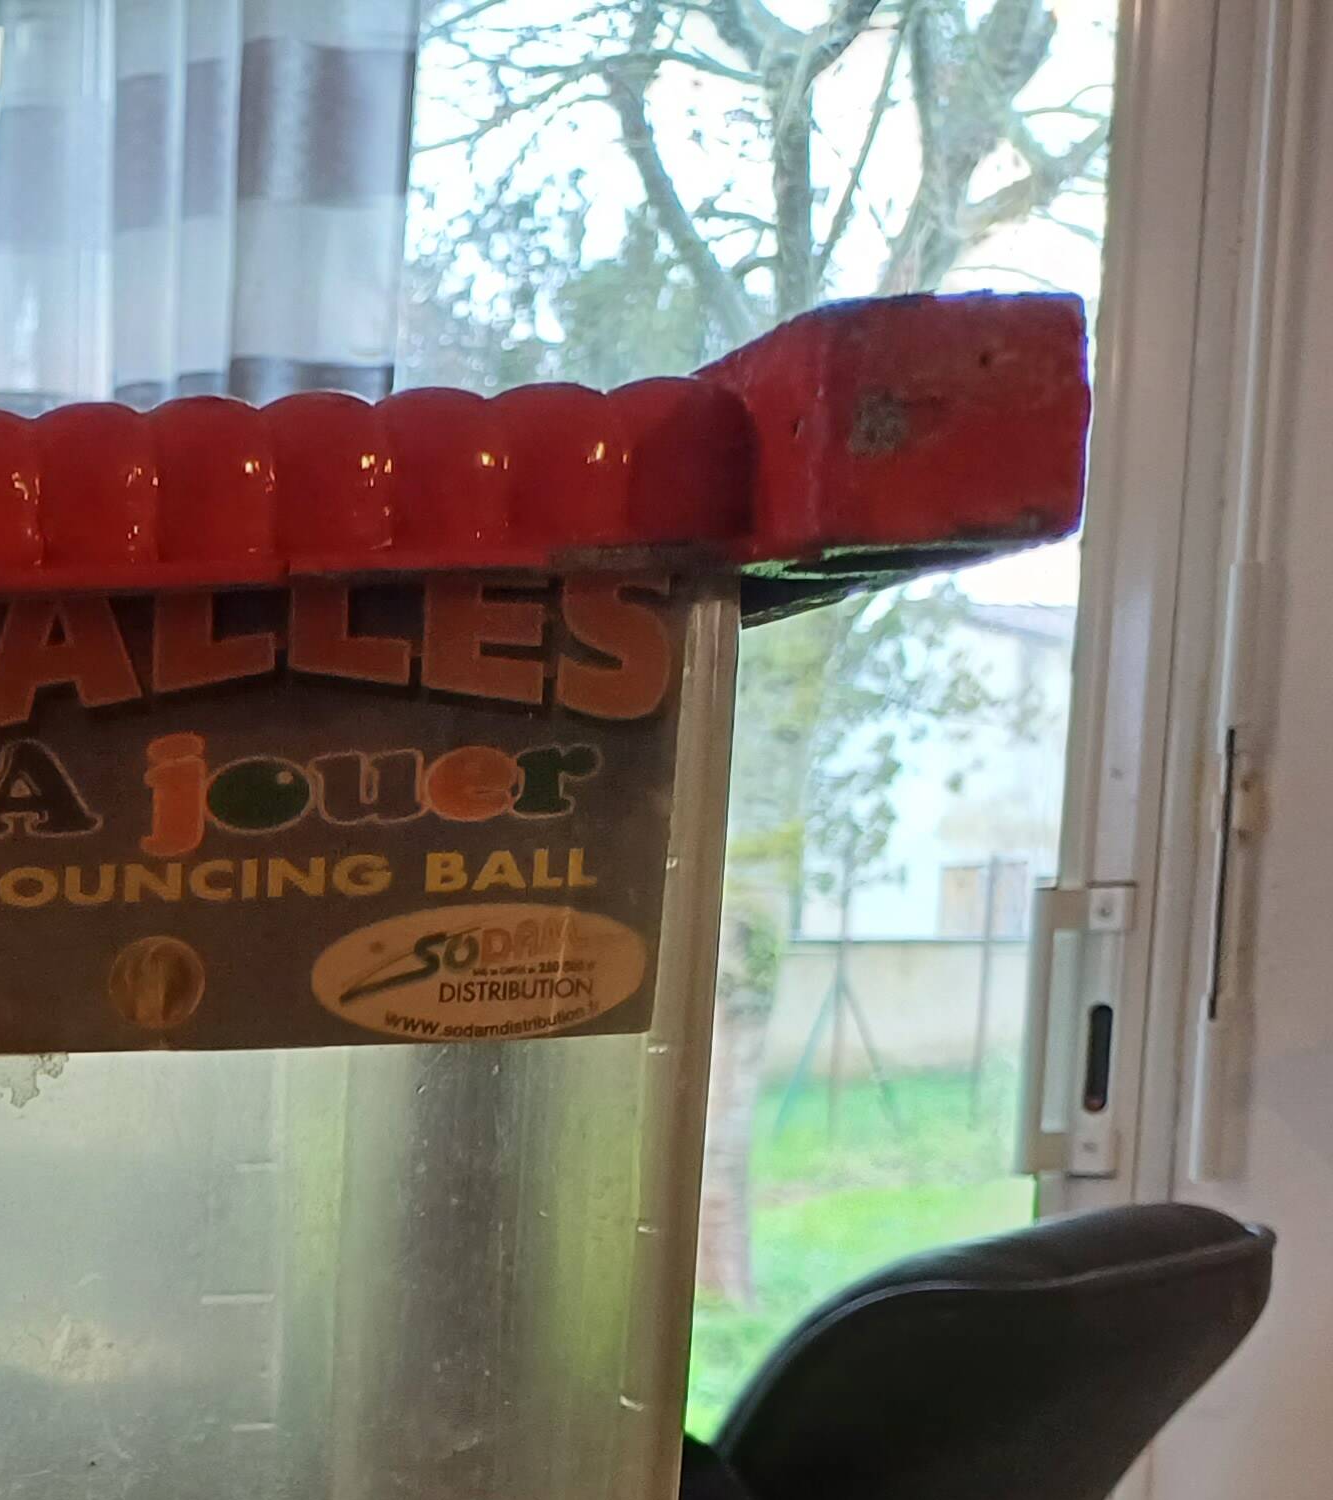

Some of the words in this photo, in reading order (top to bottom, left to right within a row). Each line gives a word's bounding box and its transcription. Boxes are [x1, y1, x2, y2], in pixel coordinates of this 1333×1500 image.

[140, 731, 604, 858] jouer
[423, 847, 598, 894] BALL
[438, 977, 594, 1003] DISTRIBUTION
